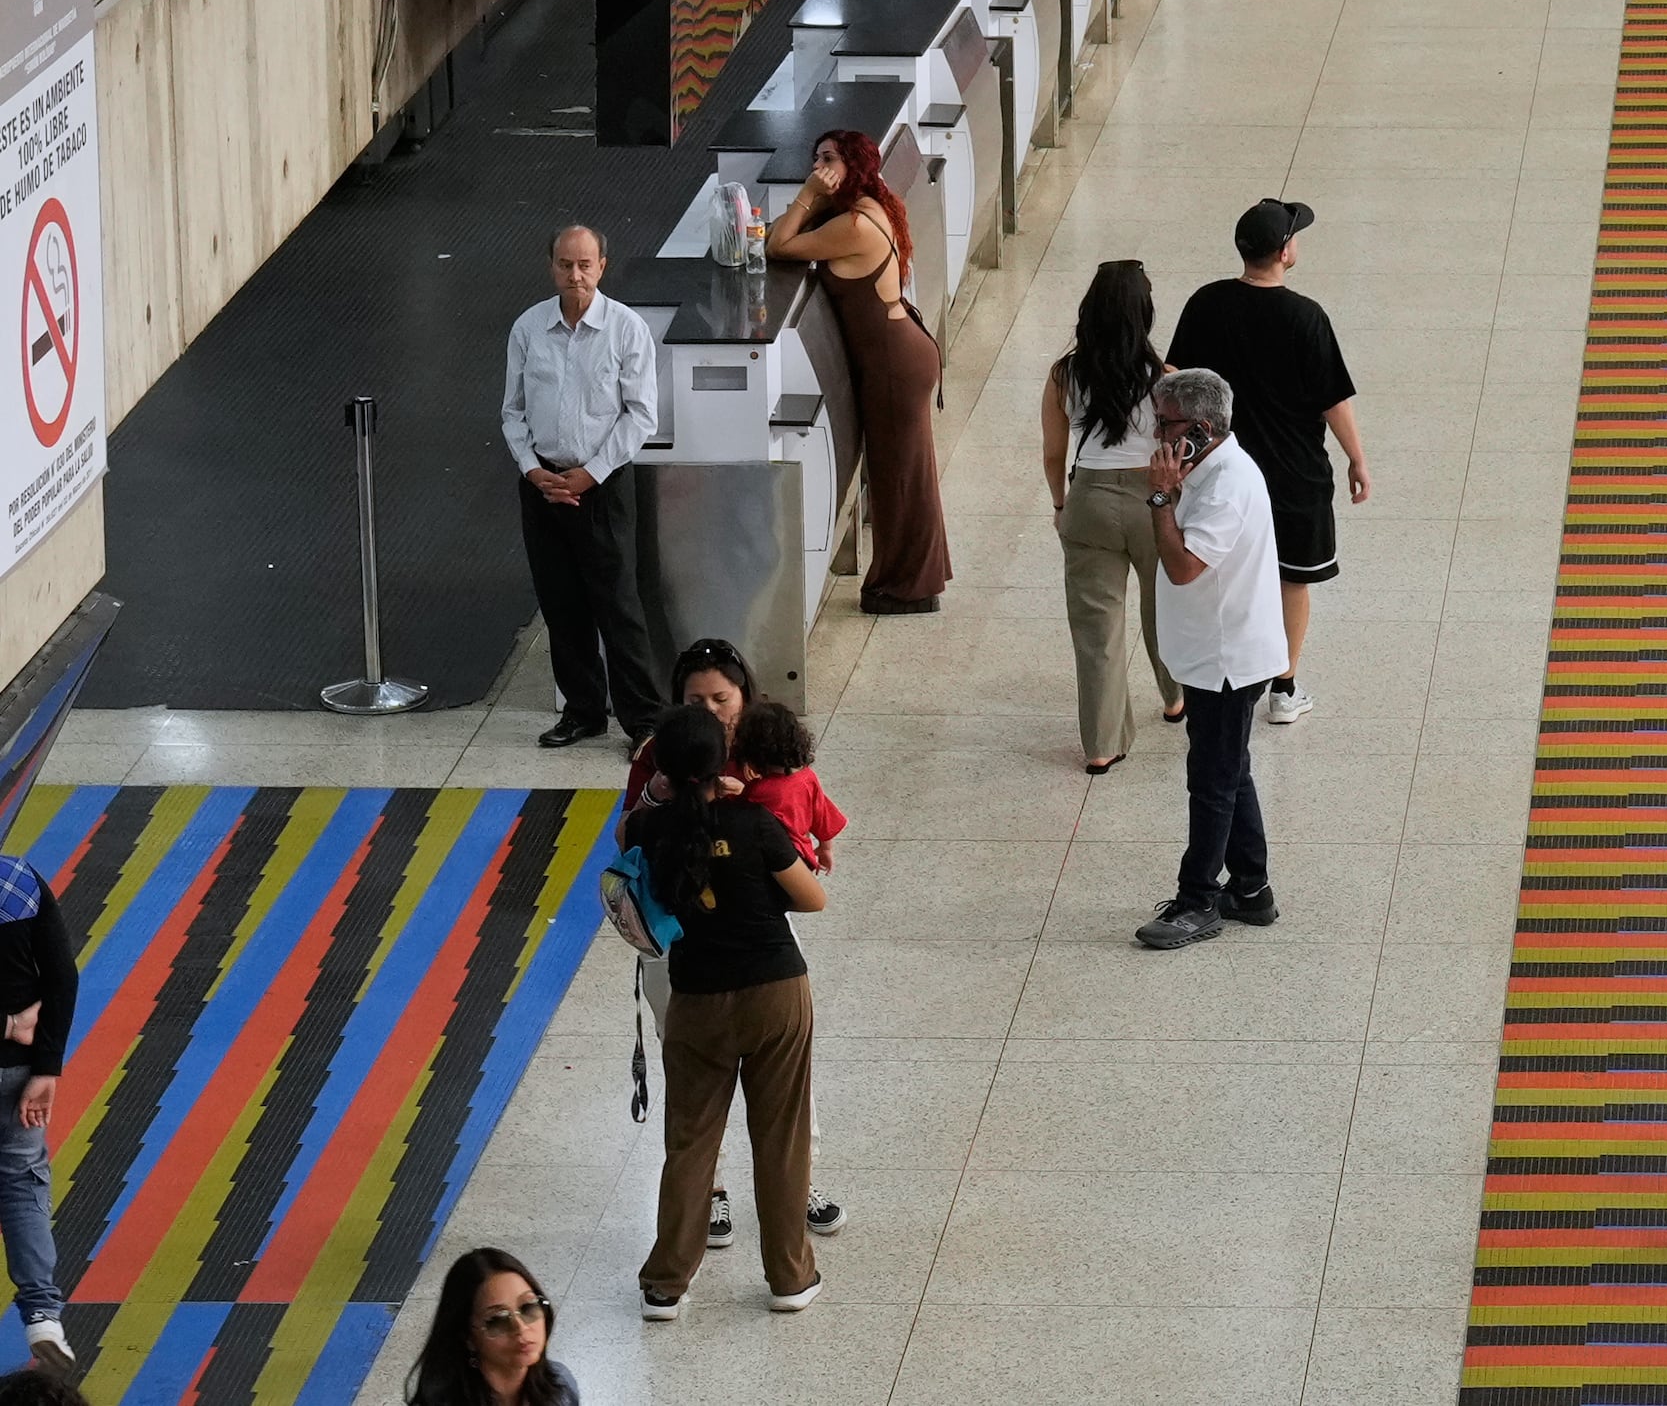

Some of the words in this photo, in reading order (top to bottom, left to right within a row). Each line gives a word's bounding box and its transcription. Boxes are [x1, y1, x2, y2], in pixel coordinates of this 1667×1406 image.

[20, 106, 30, 135] ES
[32, 94, 44, 124] UN
[46, 60, 84, 115] AMBIENTE
[0, 189, 12, 221] DE
[15, 165, 40, 208] HUMO
[43, 153, 54, 182] DE
[56, 122, 87, 170] TABACO
[18, 129, 43, 170] 100%
[45, 106, 68, 148] LIBRE
